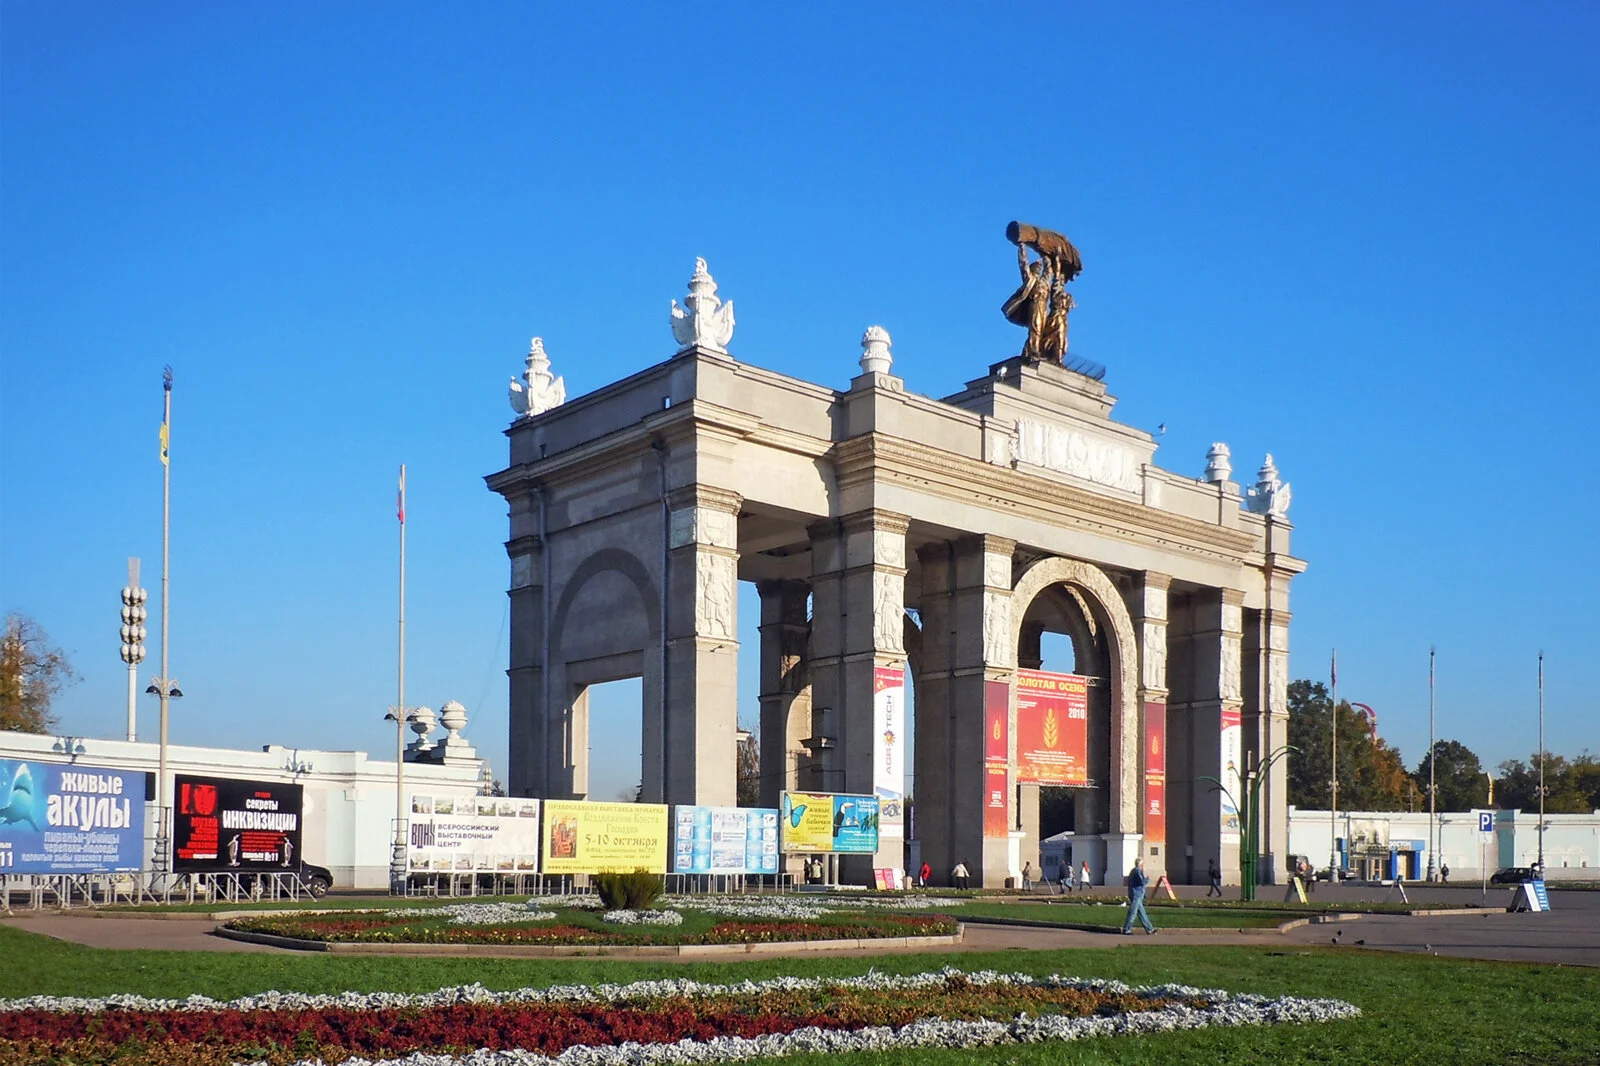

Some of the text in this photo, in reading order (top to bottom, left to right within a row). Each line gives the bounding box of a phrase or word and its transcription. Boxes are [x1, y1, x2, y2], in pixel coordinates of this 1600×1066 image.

[1058, 682, 1086, 693] ОСЕНЬ
[1068, 707, 1085, 719] 2010
[61, 772, 123, 795] живые
[47, 794, 130, 831] акулы
[222, 810, 297, 833] ИНКВИЗИЦИИ
[437, 823, 500, 831] ВСЕРОССИЙСКИЙ
[1481, 814, 1490, 830] P
[437, 832, 493, 840] ВЫСТАВОЧНЫЙ
[585, 834, 658, 847] 5-10 октября
